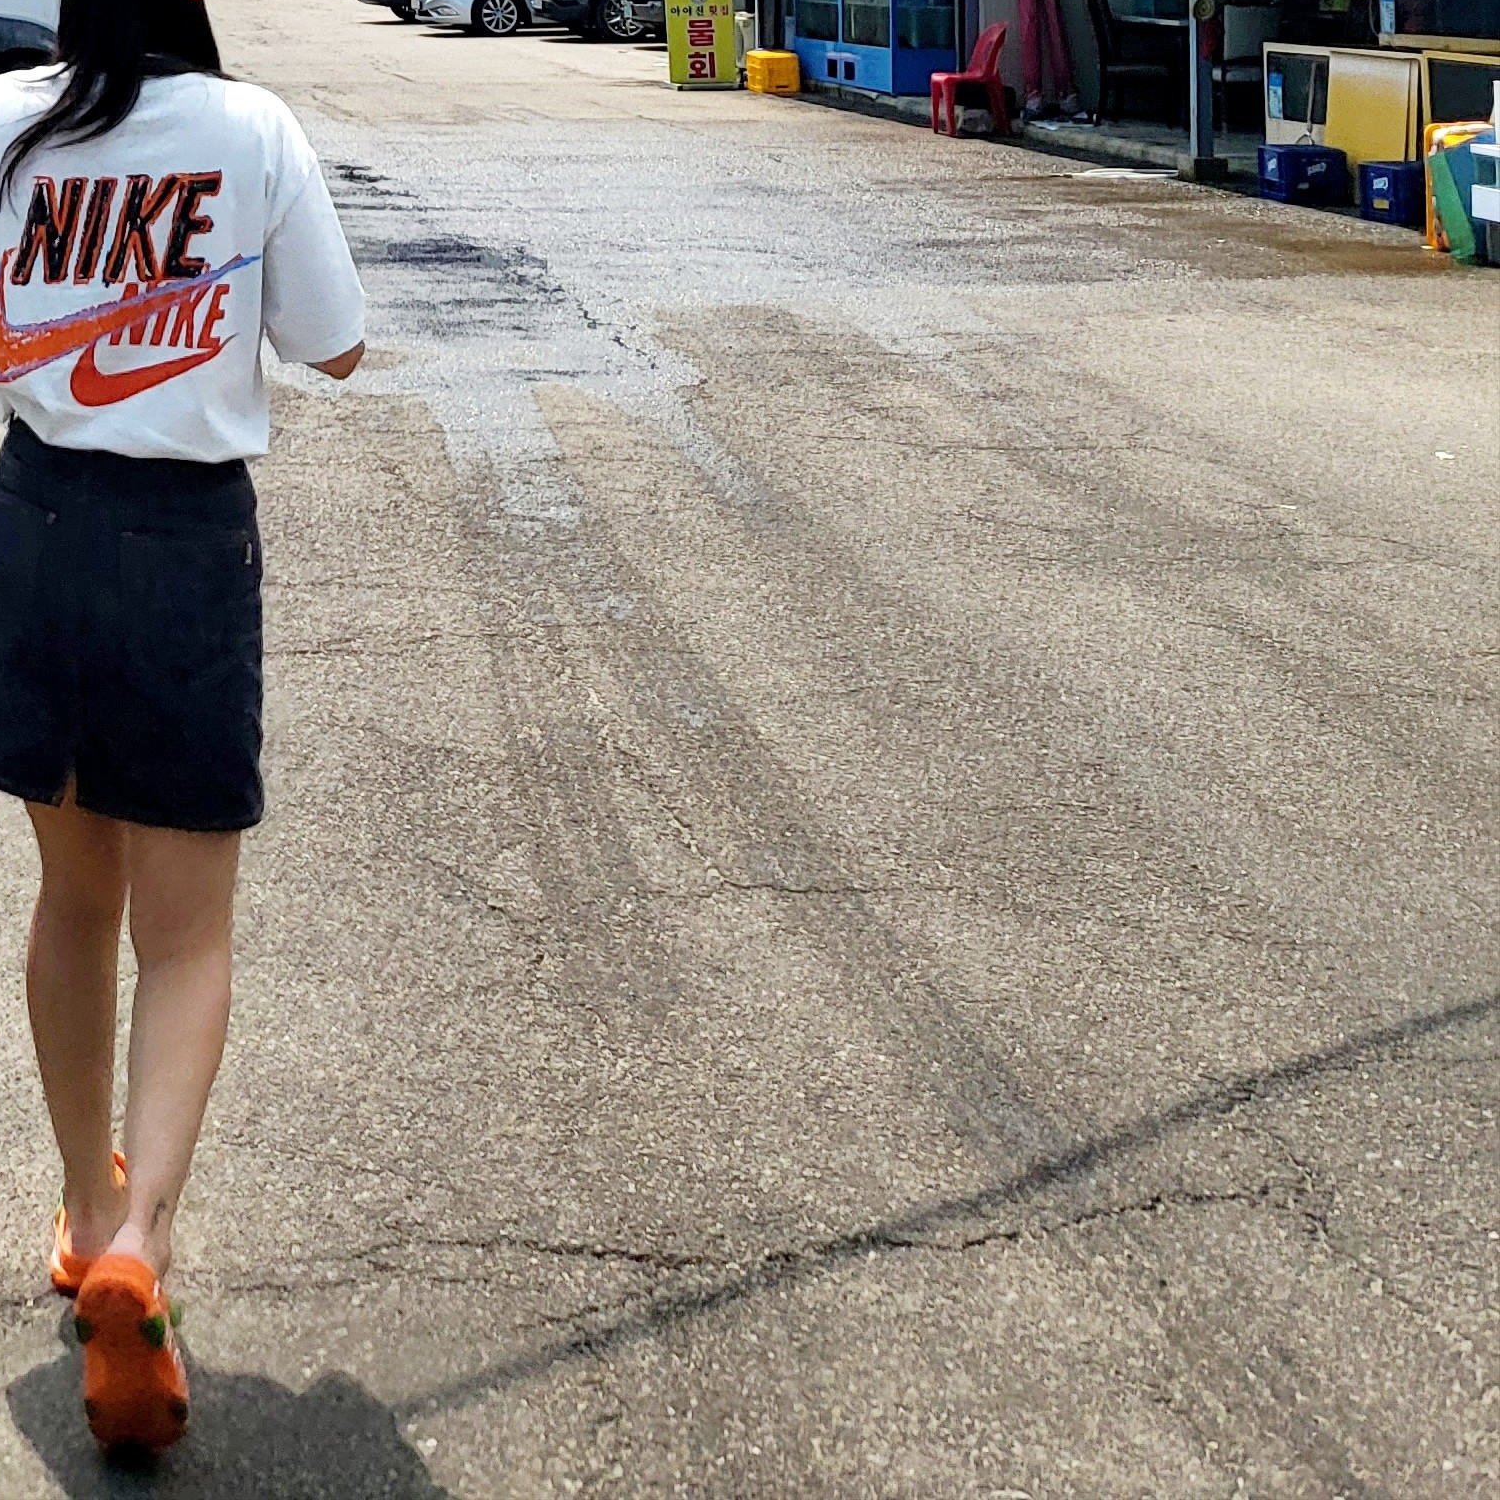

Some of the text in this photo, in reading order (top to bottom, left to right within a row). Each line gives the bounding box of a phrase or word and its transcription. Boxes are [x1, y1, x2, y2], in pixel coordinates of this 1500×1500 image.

[687, 19, 716, 79] 물회
[10, 168, 222, 286] NIKE
[109, 283, 230, 350] NIKE
